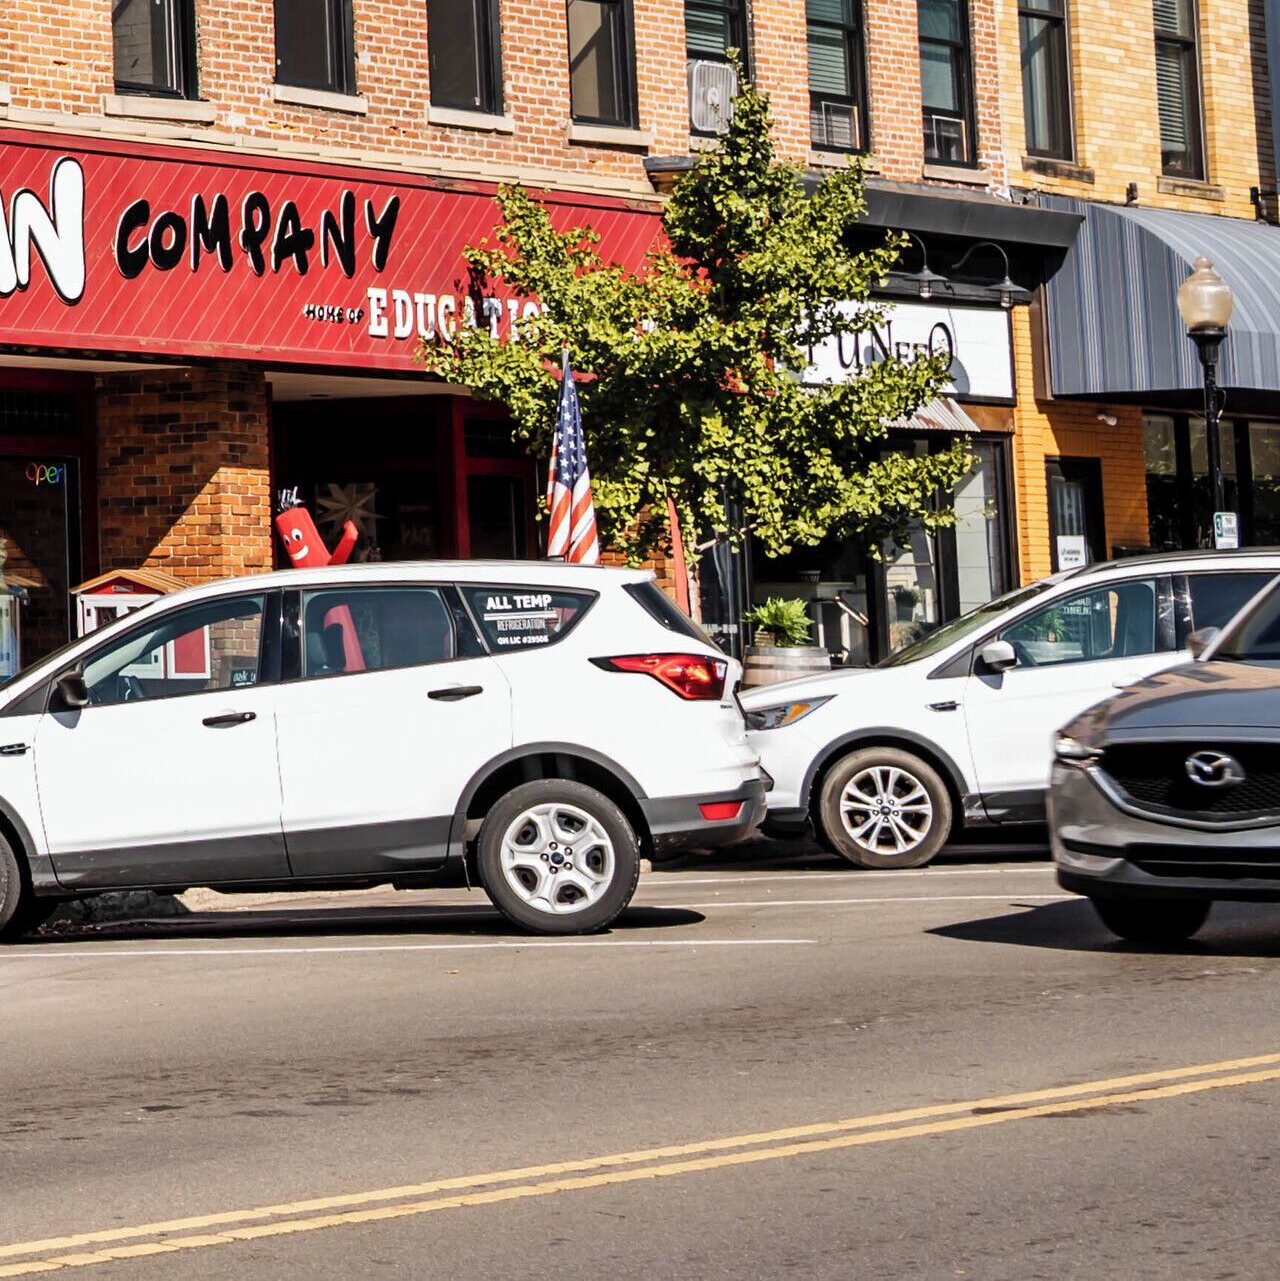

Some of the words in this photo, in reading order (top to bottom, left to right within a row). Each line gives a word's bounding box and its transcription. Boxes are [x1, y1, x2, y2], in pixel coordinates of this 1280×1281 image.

[114, 188, 401, 280] COMPANY
[303, 303, 344, 325] HOME
[345, 305, 365, 325] OF
[366, 286, 552, 343] EDUCATIO
[486, 596, 512, 610] ALL
[513, 594, 553, 609] TEMP
[496, 618, 546, 631] REFRIGERATION
